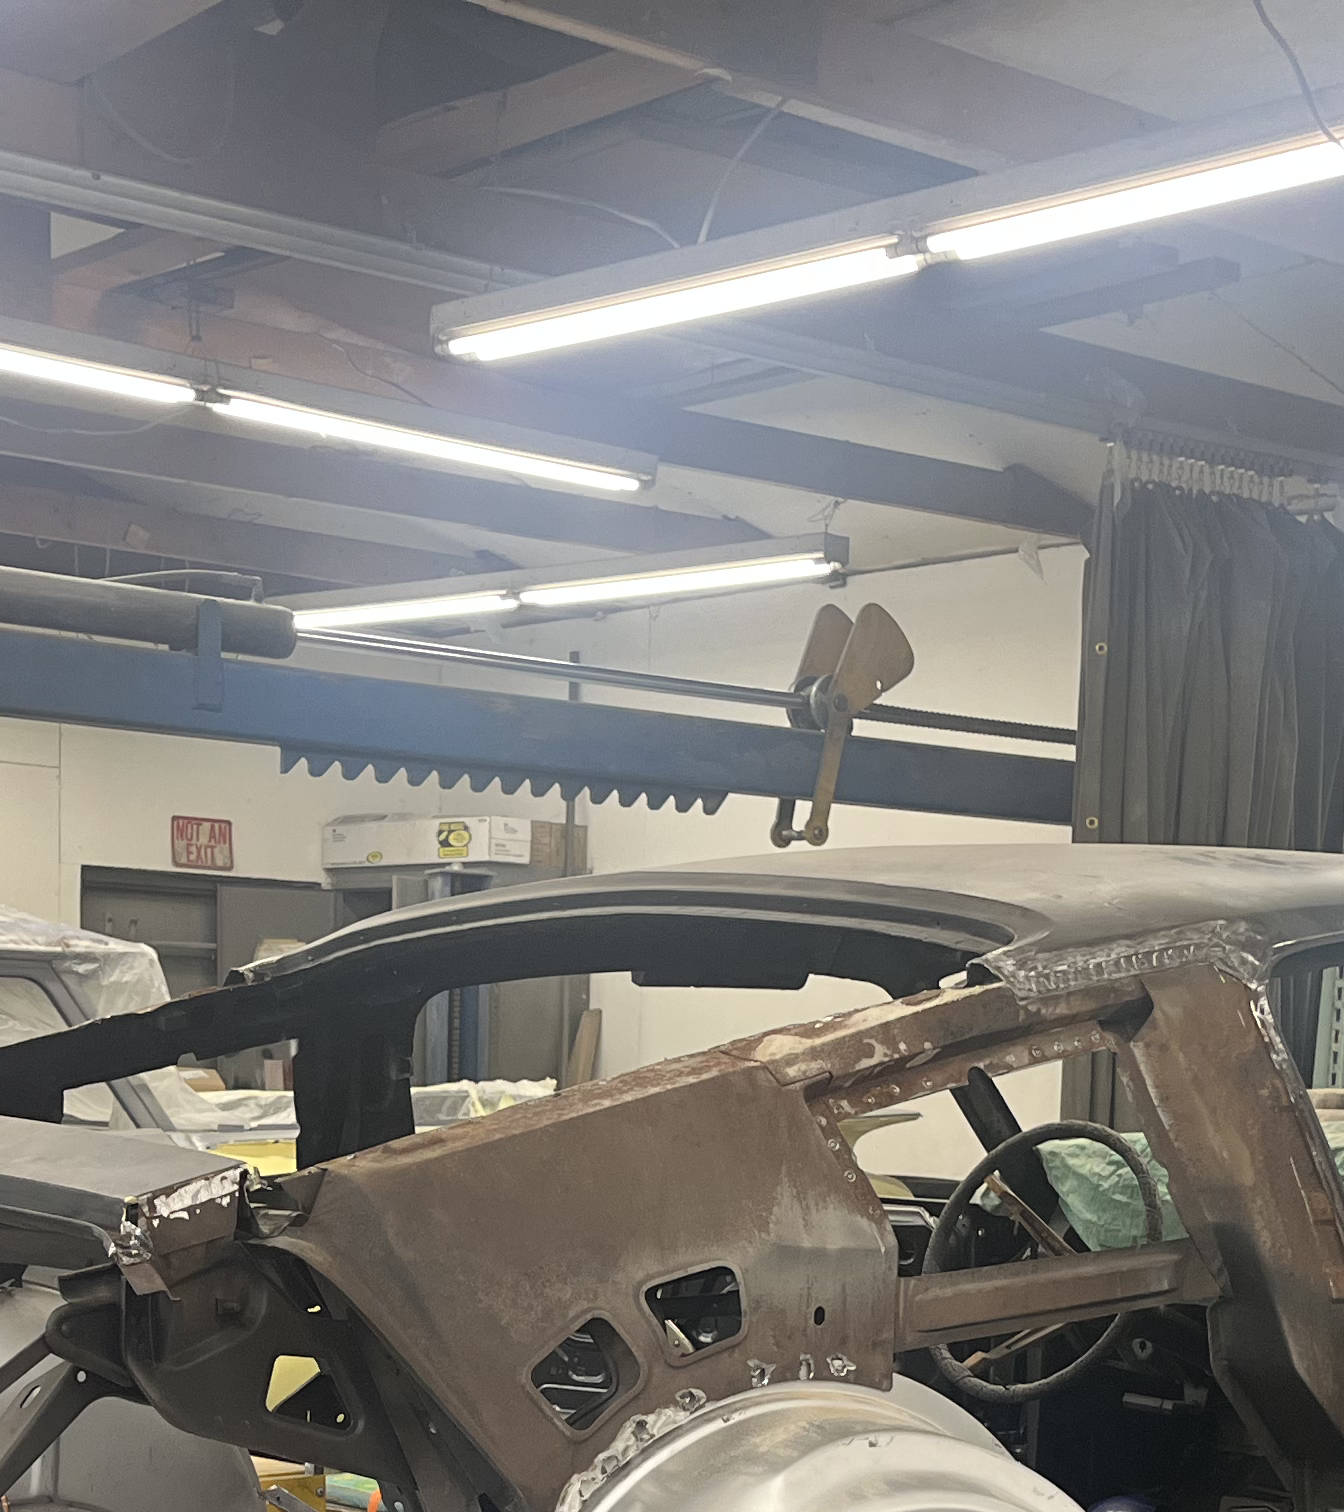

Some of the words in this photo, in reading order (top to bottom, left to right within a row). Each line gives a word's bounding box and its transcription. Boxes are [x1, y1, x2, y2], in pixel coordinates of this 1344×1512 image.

[176, 820, 203, 842] NOT
[209, 823, 227, 845] AN
[186, 843, 217, 866] EXIT
